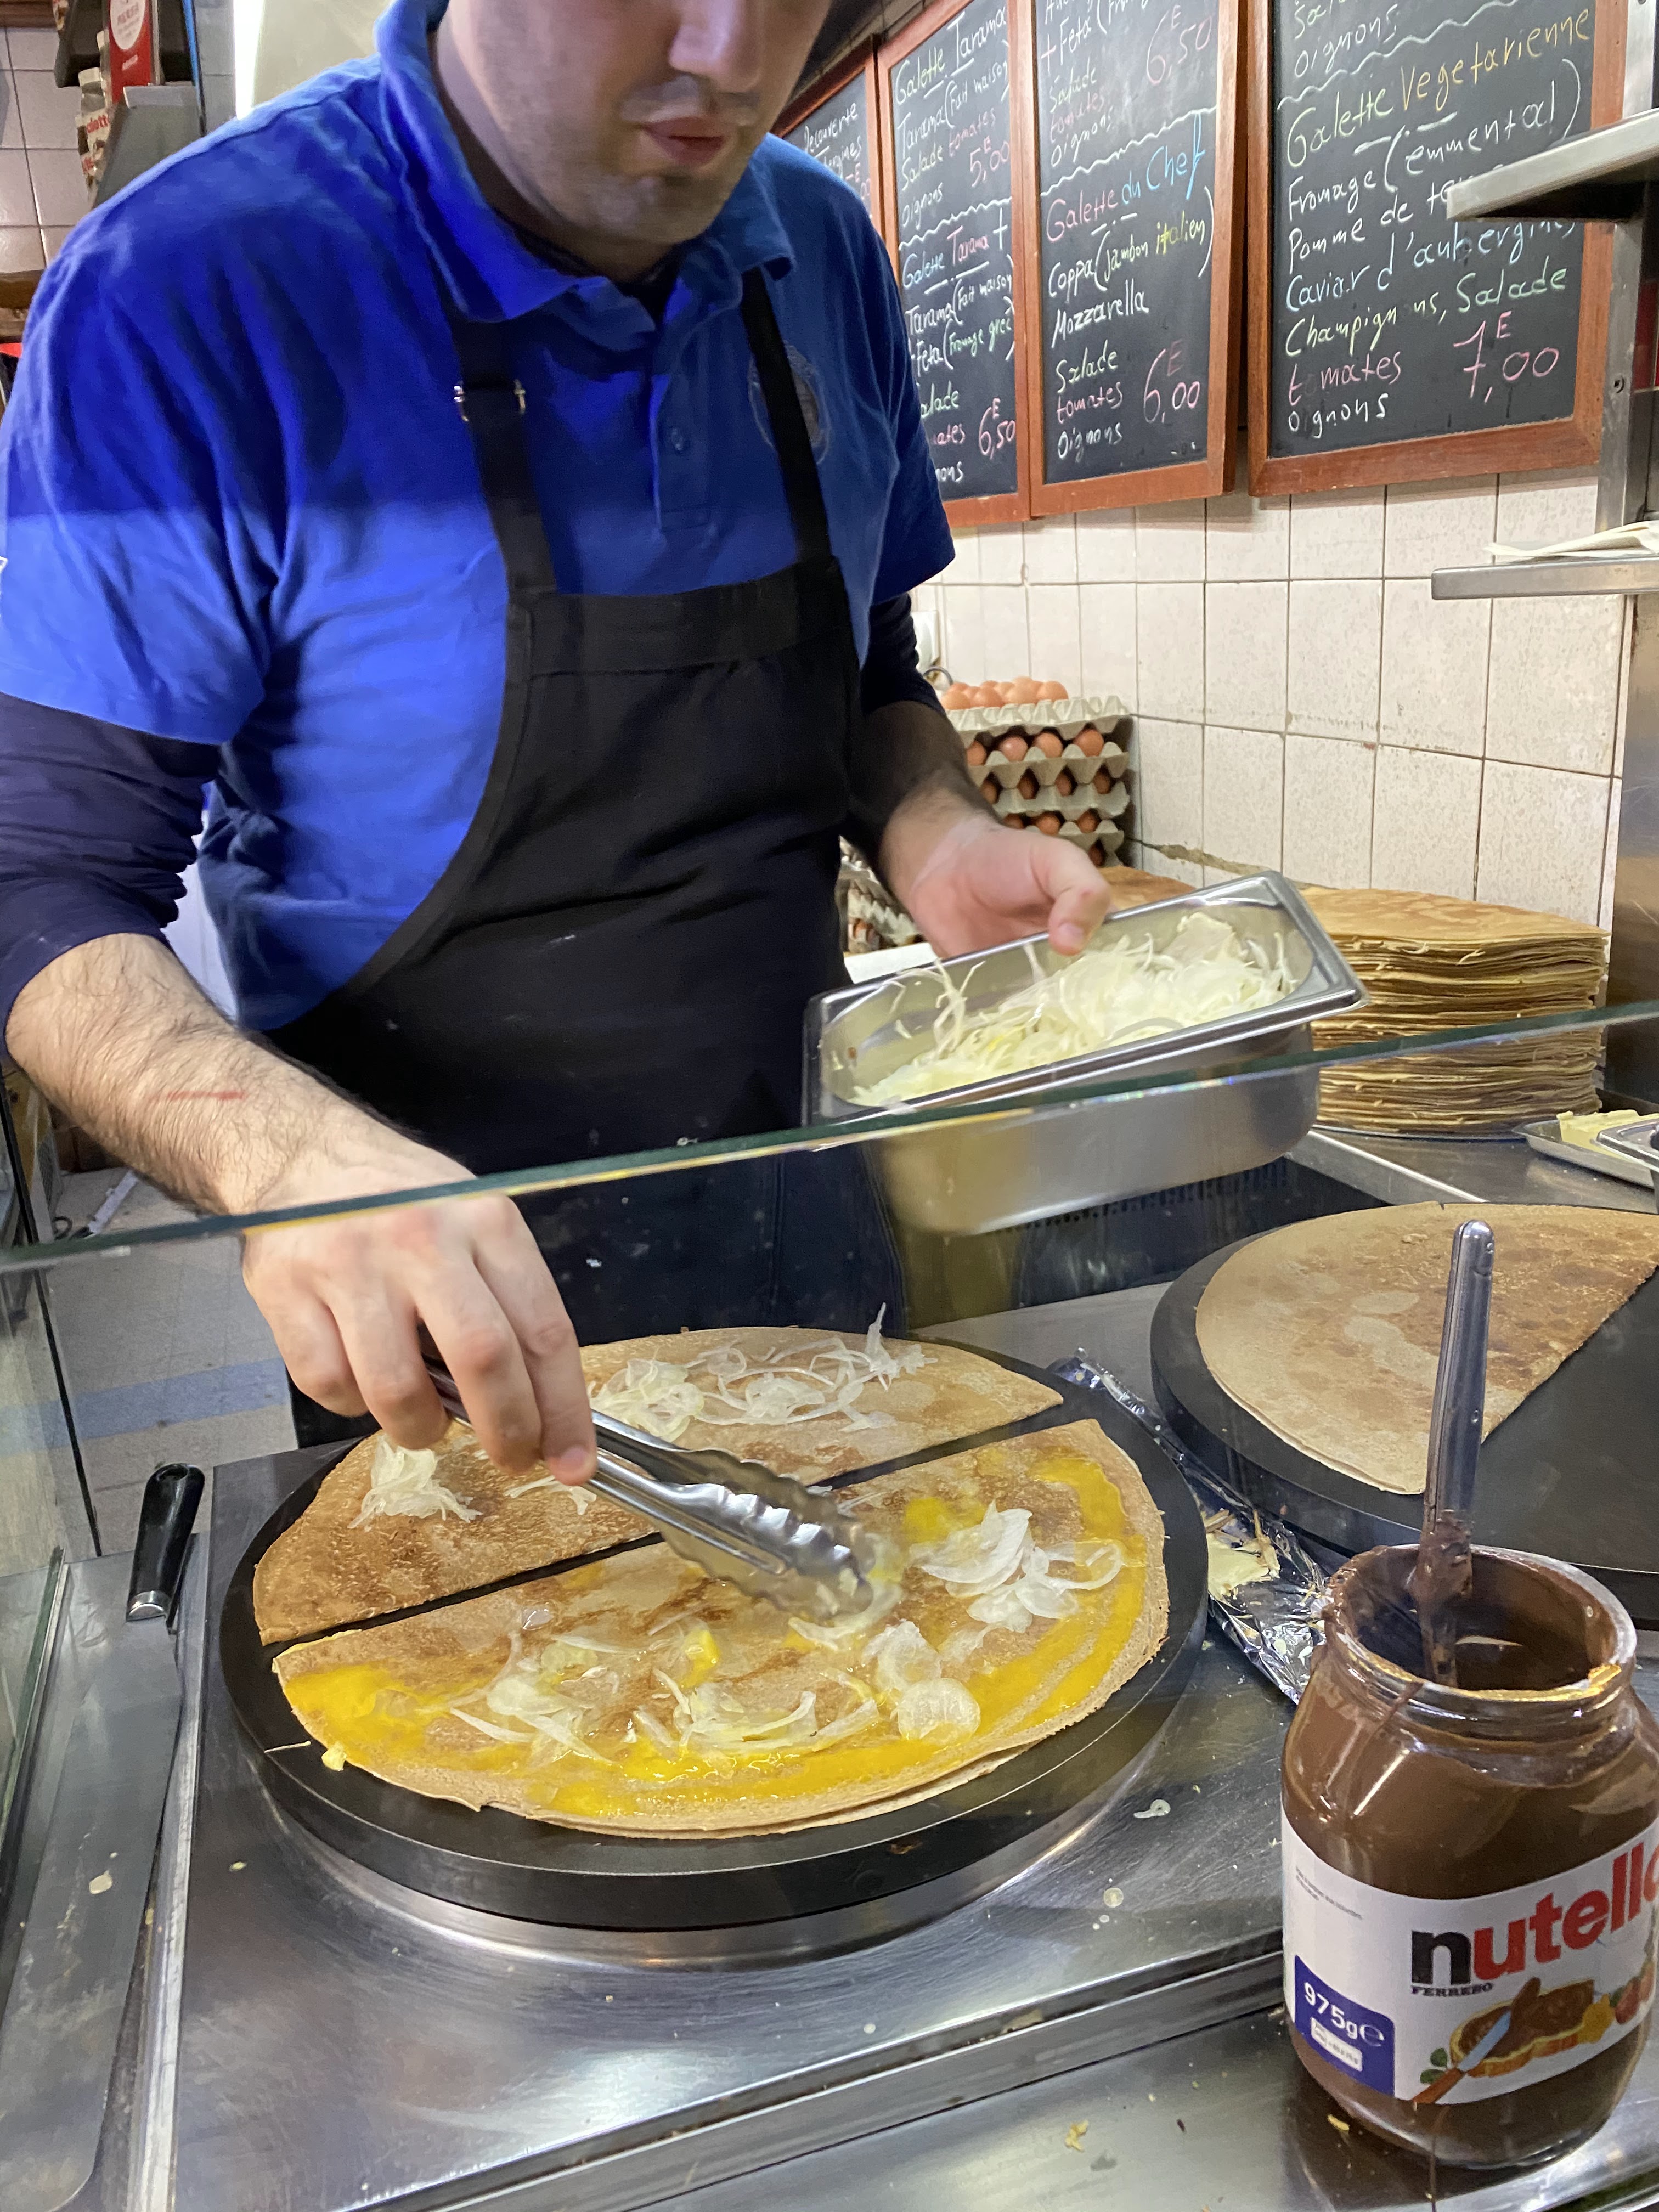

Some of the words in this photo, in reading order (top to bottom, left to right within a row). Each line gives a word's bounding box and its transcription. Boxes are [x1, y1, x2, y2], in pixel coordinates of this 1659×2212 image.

[895, 47, 945, 104] Galette
[946, 6, 1006, 69] Tarama
[1060, 16, 1092, 65] Feta
[1288, 89, 1393, 167] Galette
[1401, 9, 1589, 111] Vegetarienne
[897, 105, 946, 159] Tarama
[902, 140, 944, 191] Salade
[949, 108, 996, 157] tomates
[1046, 189, 1118, 242] Galette
[1121, 170, 1141, 205] du
[1146, 112, 1205, 200] Chef
[1289, 170, 1376, 222] Fromage
[902, 250, 945, 289] Galette
[947, 225, 989, 267] Tarama
[1289, 218, 1365, 274] Pomme
[1380, 194, 1414, 225] de
[1048, 258, 1095, 303] Coppa
[1286, 265, 1370, 312] Caviar
[1456, 255, 1567, 313] Salade
[905, 303, 955, 335] Tarama
[1051, 278, 1149, 349] Mozzarella
[917, 380, 959, 419] alade
[1056, 381, 1122, 424] tomates
[931, 424, 966, 445] ates
[935, 461, 963, 483] nons
